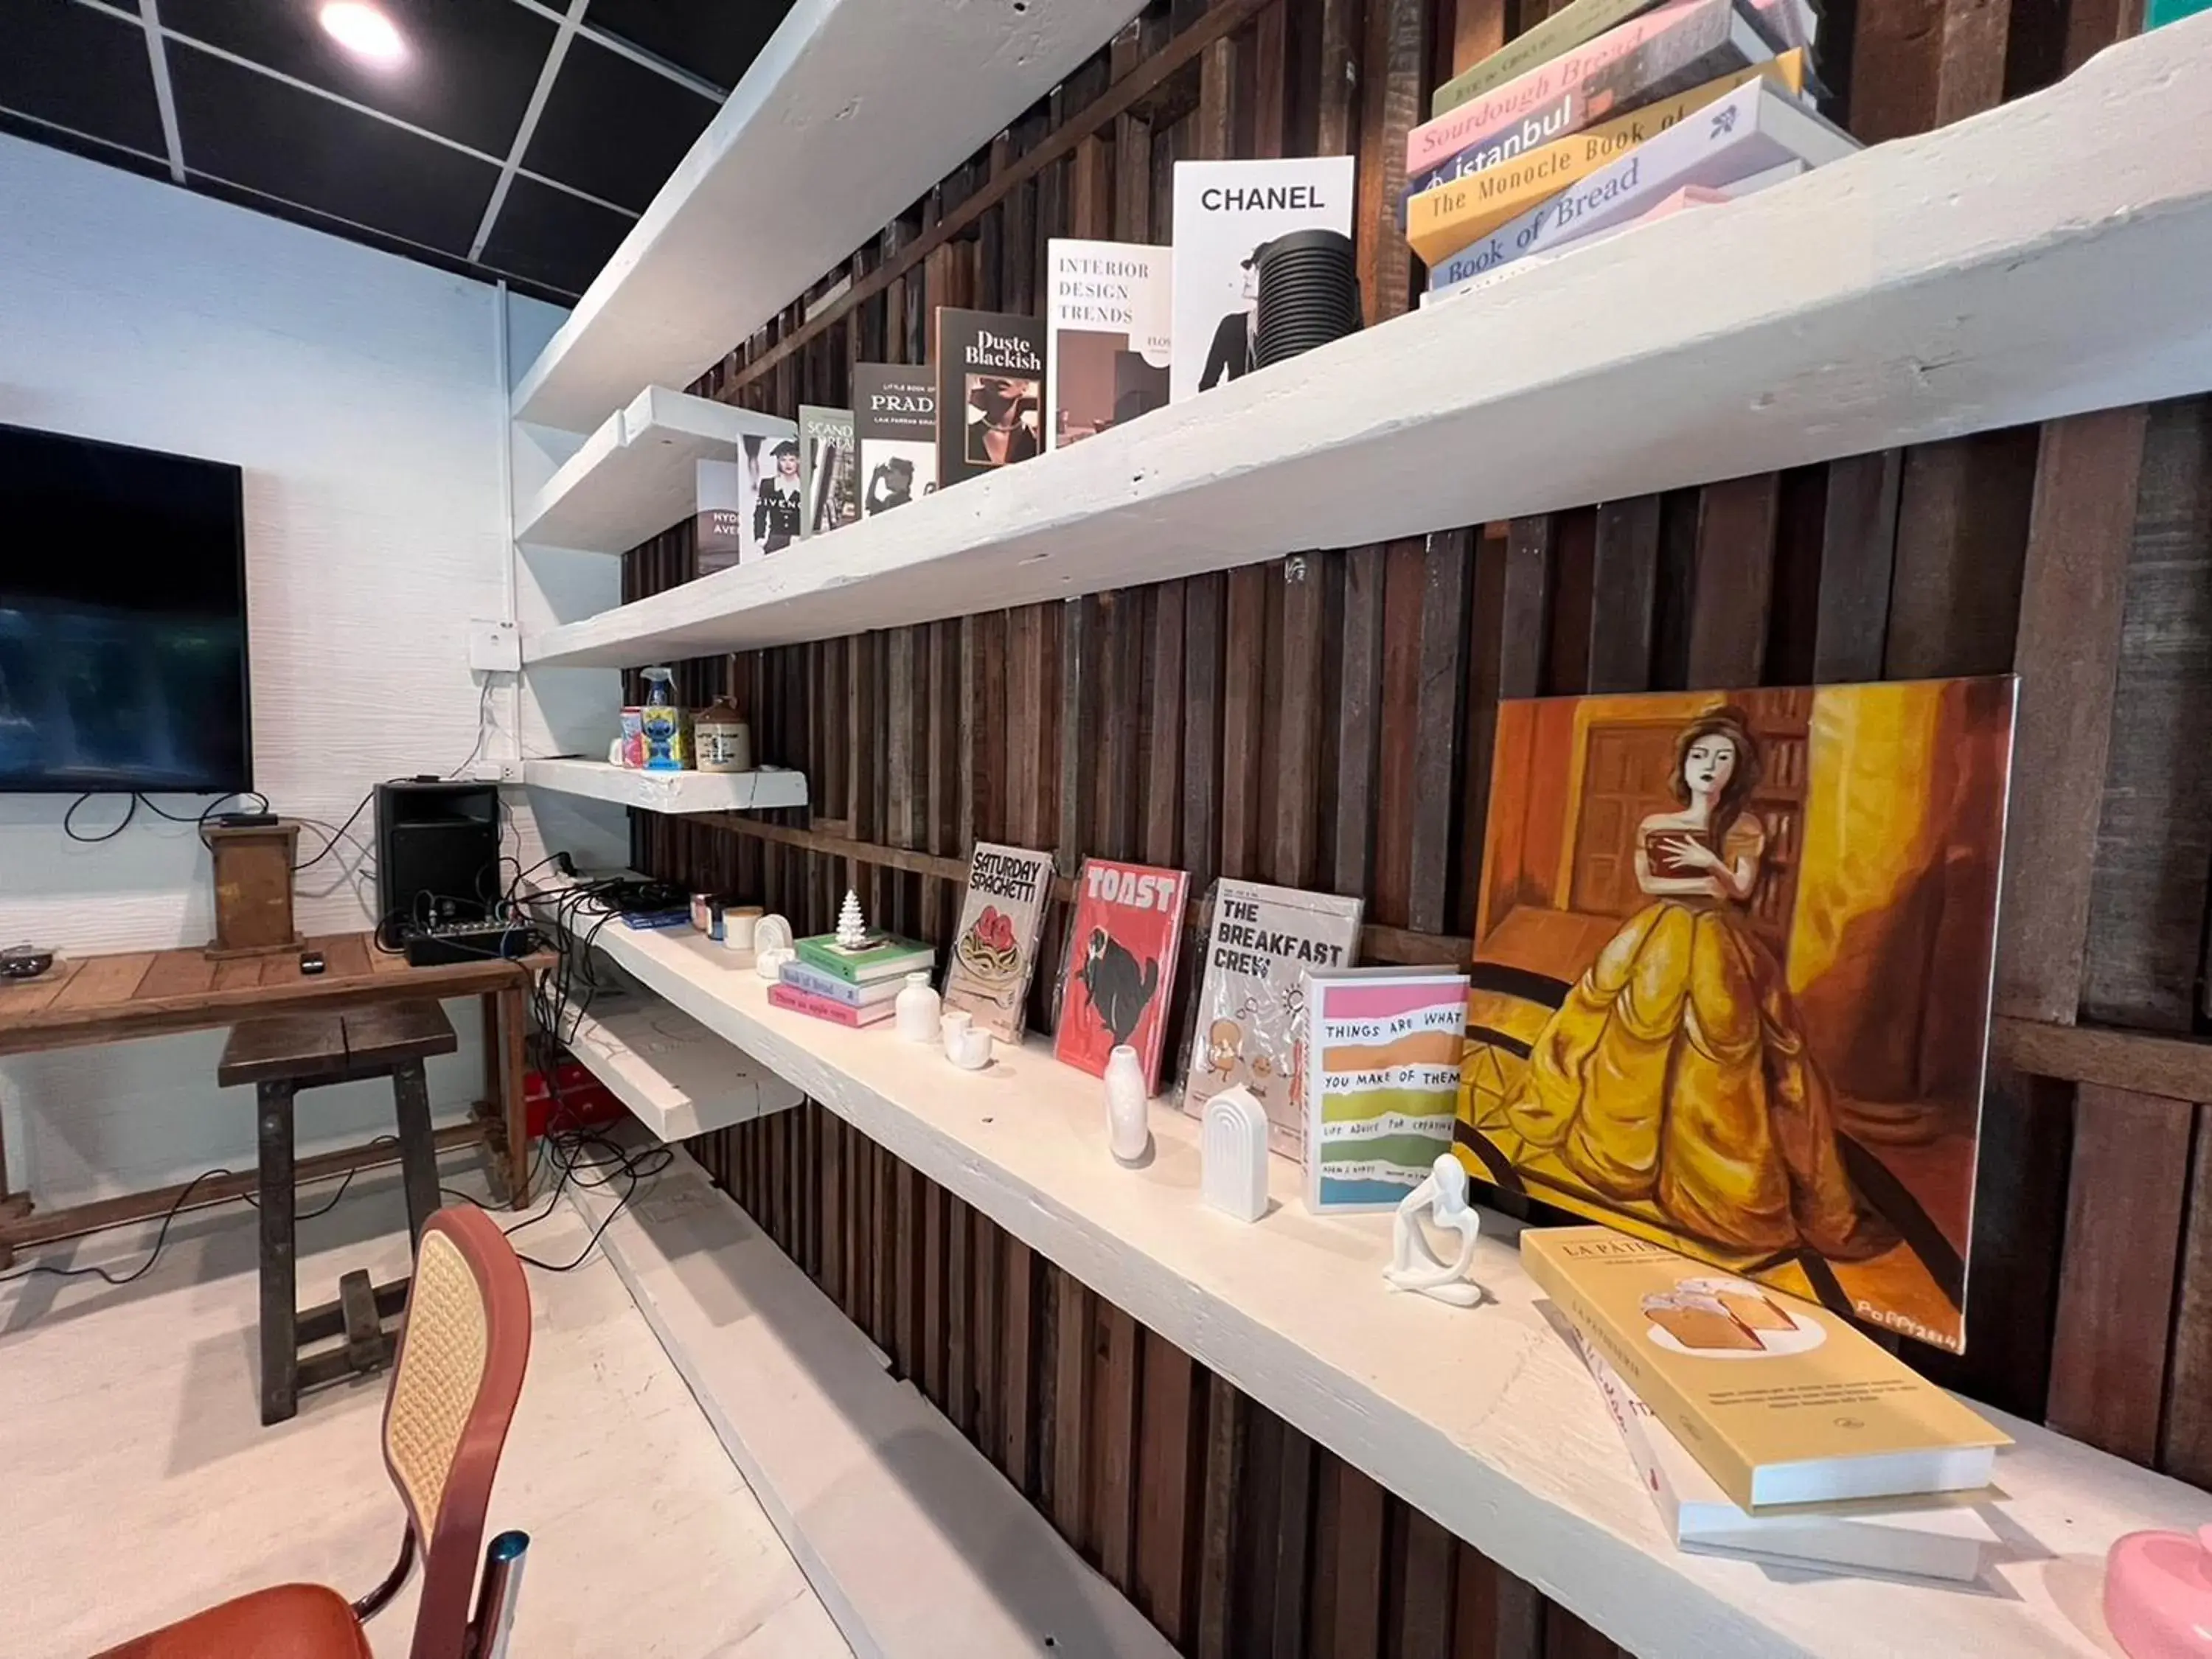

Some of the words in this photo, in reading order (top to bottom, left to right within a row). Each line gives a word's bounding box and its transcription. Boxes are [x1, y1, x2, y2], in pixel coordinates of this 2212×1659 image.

[1422, 75, 1549, 153] Sourdough
[1561, 27, 1644, 87] Bread
[1432, 189, 1466, 218] The
[1478, 150, 1571, 201] Monocle
[1585, 122, 1645, 162] Book
[1201, 186, 1325, 211] CHANEL
[1448, 240, 1504, 285] Book
[1517, 211, 1545, 249] of
[1555, 157, 1640, 228] Bread
[1060, 257, 1150, 279] INTERIOR
[1059, 281, 1129, 299] DESIGN
[1059, 305, 1133, 324] TRENDS
[965, 346, 1041, 370] Blackish
[973, 851, 1041, 883] SATURDAY
[970, 872, 1036, 904] SPAGHETTI
[1088, 866, 1176, 912] TOAST
[1223, 900, 1259, 922] THE
[1217, 922, 1343, 968] BREAKFAST
[1326, 1026, 1380, 1038] THINGS
[1391, 1018, 1412, 1033] ARE
[1424, 1011, 1461, 1026] WHAT
[1325, 1076, 1349, 1089] YOU
[1357, 1071, 1391, 1085] MAKE
[1399, 1071, 1416, 1083] OF
[1423, 1072, 1461, 1085] THEM
